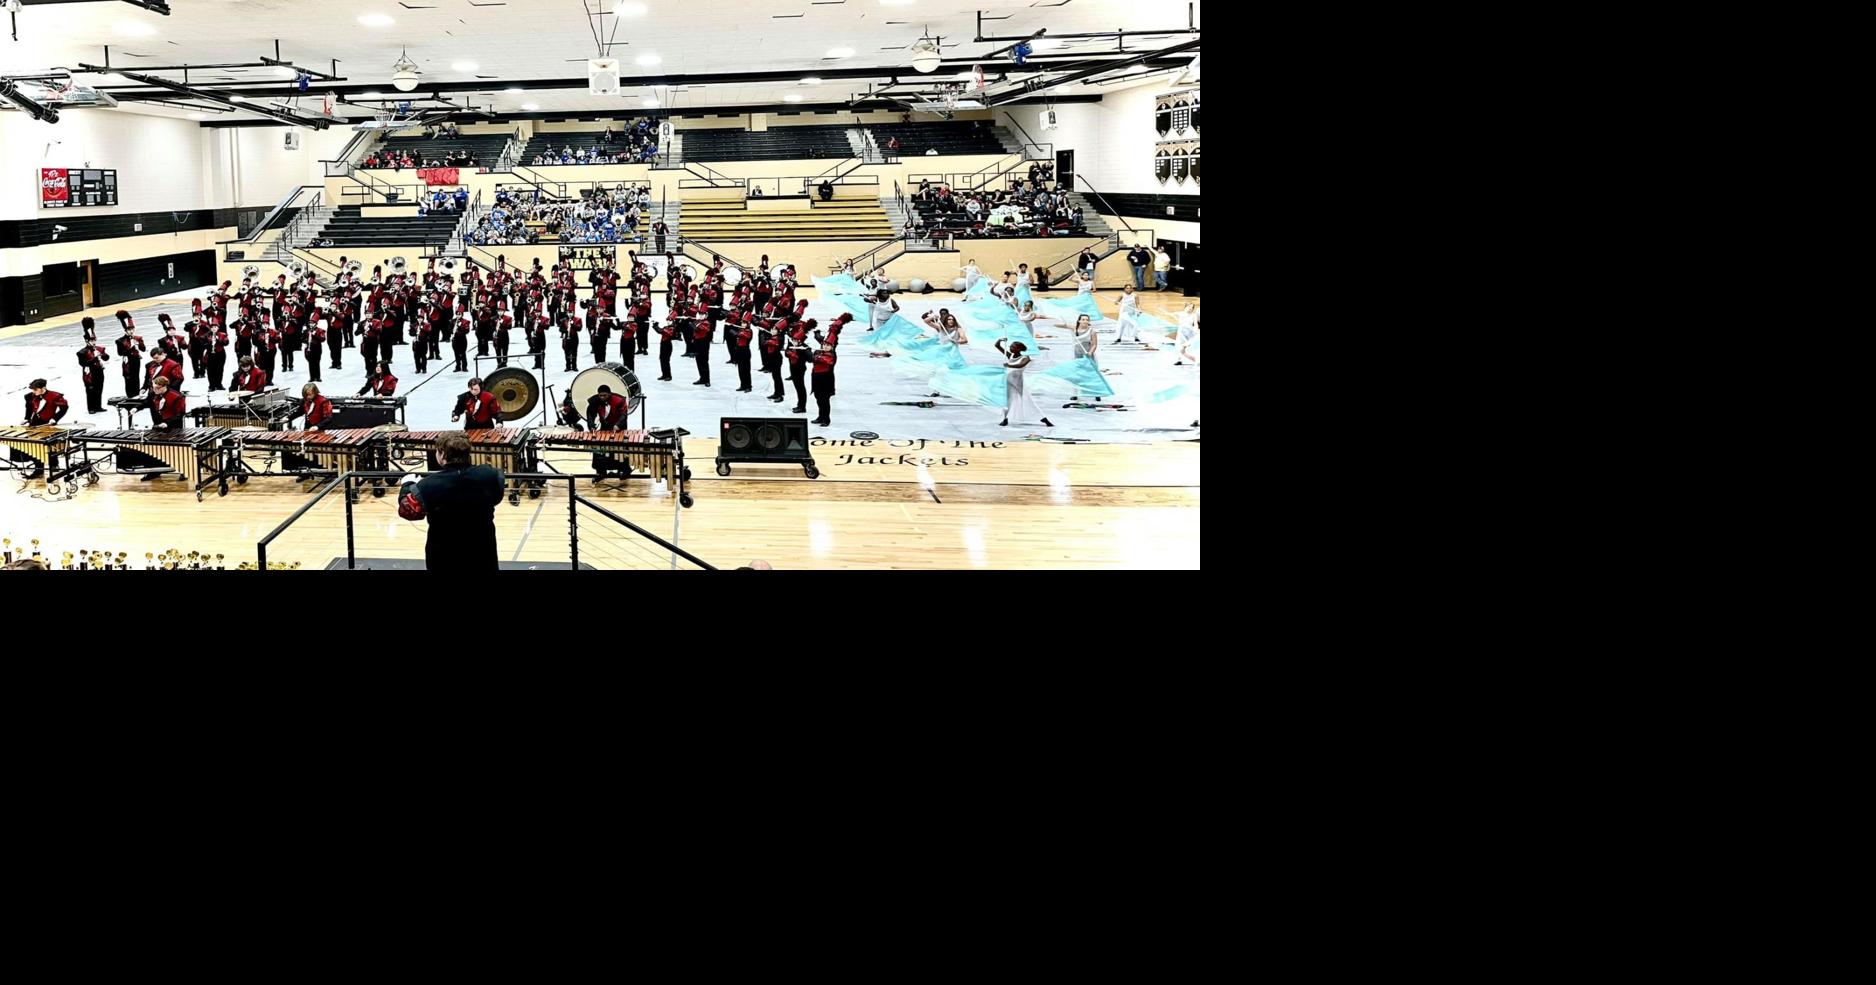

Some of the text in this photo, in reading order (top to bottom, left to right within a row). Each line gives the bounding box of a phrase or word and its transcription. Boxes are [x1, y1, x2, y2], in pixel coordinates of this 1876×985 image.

[573, 247, 601, 258] THE
[808, 436, 874, 447] ome
[834, 453, 969, 468] Jackets
